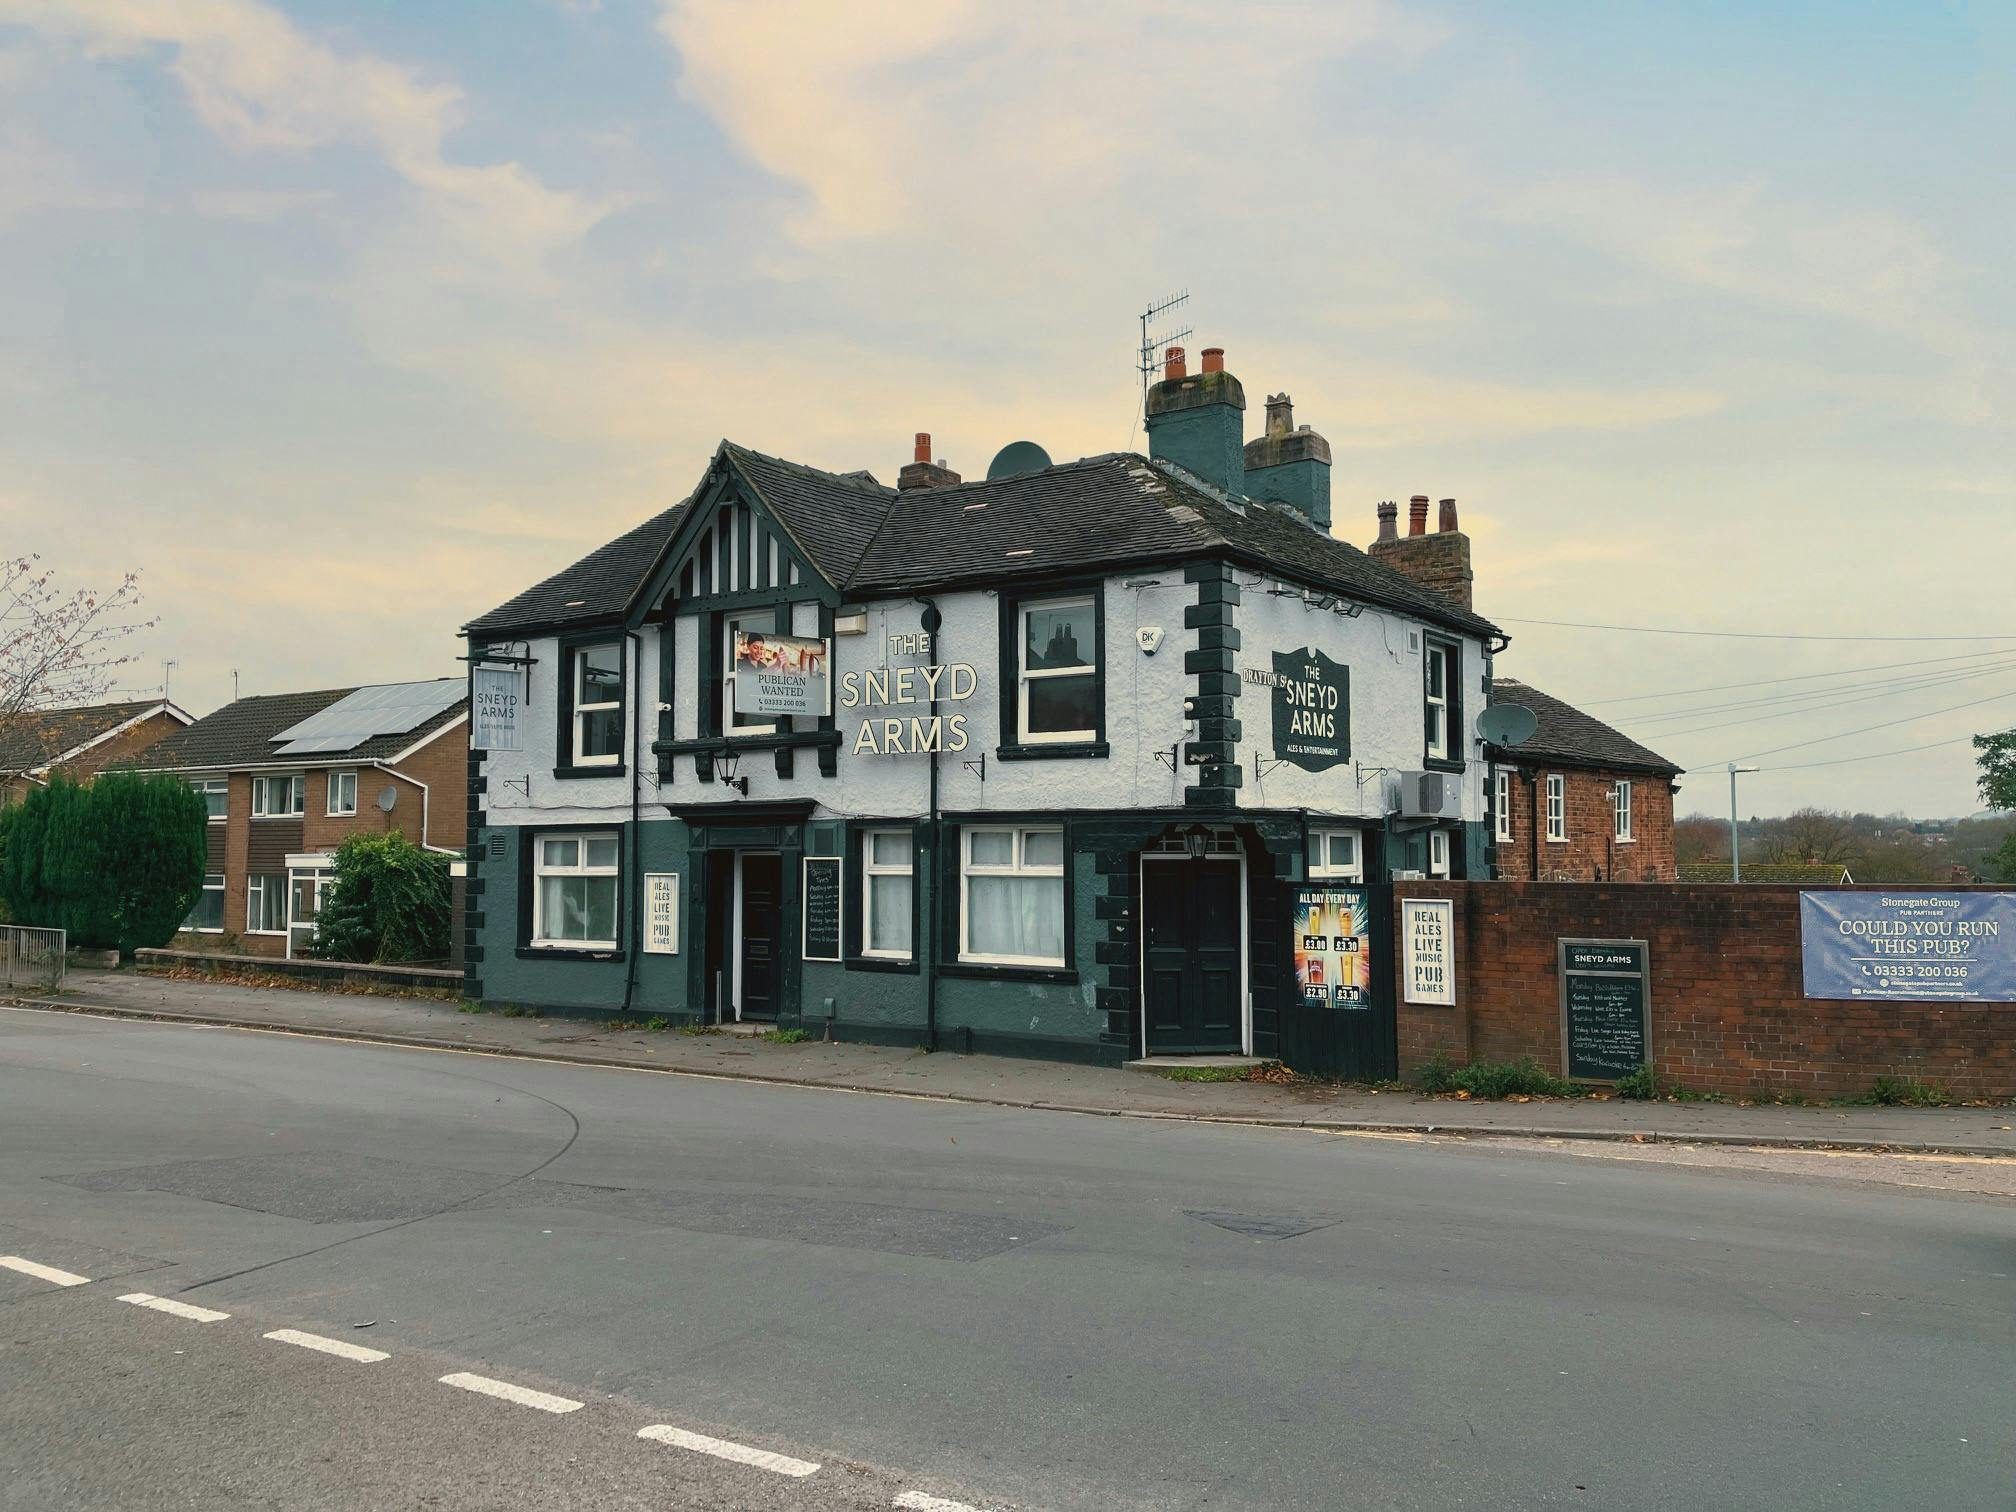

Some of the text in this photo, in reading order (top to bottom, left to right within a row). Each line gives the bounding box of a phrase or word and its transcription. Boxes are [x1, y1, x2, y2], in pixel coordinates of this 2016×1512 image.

[1142, 632, 1154, 641] DK
[889, 633, 931, 655] THE
[1243, 668, 1277, 687] DRAYTON
[1304, 665, 1320, 680] THE
[758, 674, 806, 686] PUBLICAN
[840, 663, 977, 708] SNEYD
[761, 686, 804, 696] WANTED
[1286, 679, 1338, 710] SNEYD
[478, 693, 518, 706] SNEYD
[480, 707, 515, 719] ARMS
[1291, 710, 1335, 738] ARMS
[852, 714, 969, 755] ARMS
[1287, 744, 1338, 756] ALES & ENTERTAINMENT
[655, 892, 670, 901] ALES
[1299, 893, 1360, 904] ALL DAY EVERY DAY
[654, 903, 670, 913] LIVE
[1881, 897, 1960, 909] Stonegate Group
[1414, 911, 1442, 923] REAL
[653, 924, 670, 937] PUB
[1415, 924, 1442, 935] ALES
[1839, 920, 1999, 936] COULD YOU RUN
[1305, 940, 1326, 950] £3.00
[1335, 941, 1357, 951] £3.30
[1414, 939, 1442, 951] LIVE
[1870, 939, 1970, 954] THIS PUB?
[1415, 953, 1442, 963] MUSIC
[1574, 954, 1632, 964] SNEYD ARMS
[1415, 966, 1443, 982] PUB
[1874, 966, 1968, 977] 03333 200 036
[1306, 988, 1327, 998] £2.90
[1416, 983, 1444, 993] GAMES
[1337, 990, 1358, 1000] £3.30
